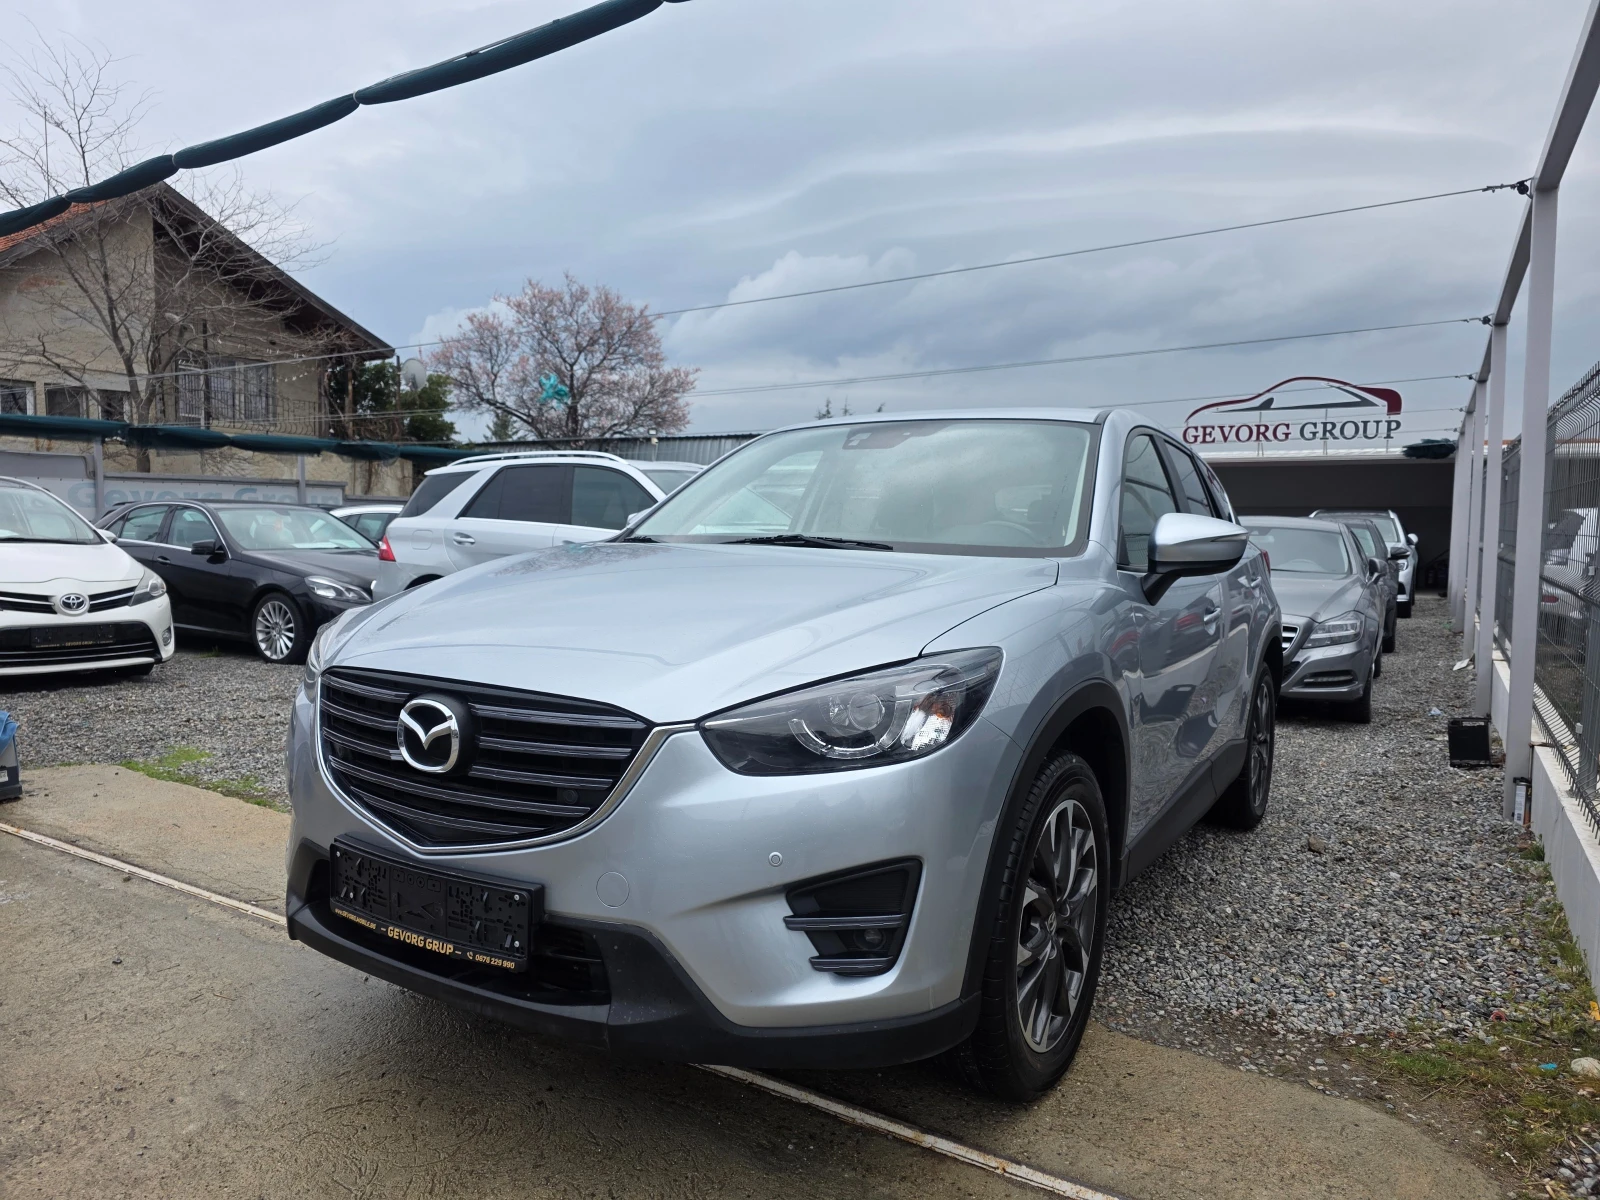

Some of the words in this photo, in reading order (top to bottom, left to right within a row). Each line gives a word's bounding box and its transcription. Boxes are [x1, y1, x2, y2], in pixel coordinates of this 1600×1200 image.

[1182, 422, 1291, 444] GEVORG
[1300, 419, 1402, 441] GROUP
[387, 926, 425, 947] GEVORG
[425, 938, 454, 955] GRUP
[502, 960, 515, 969] 990
